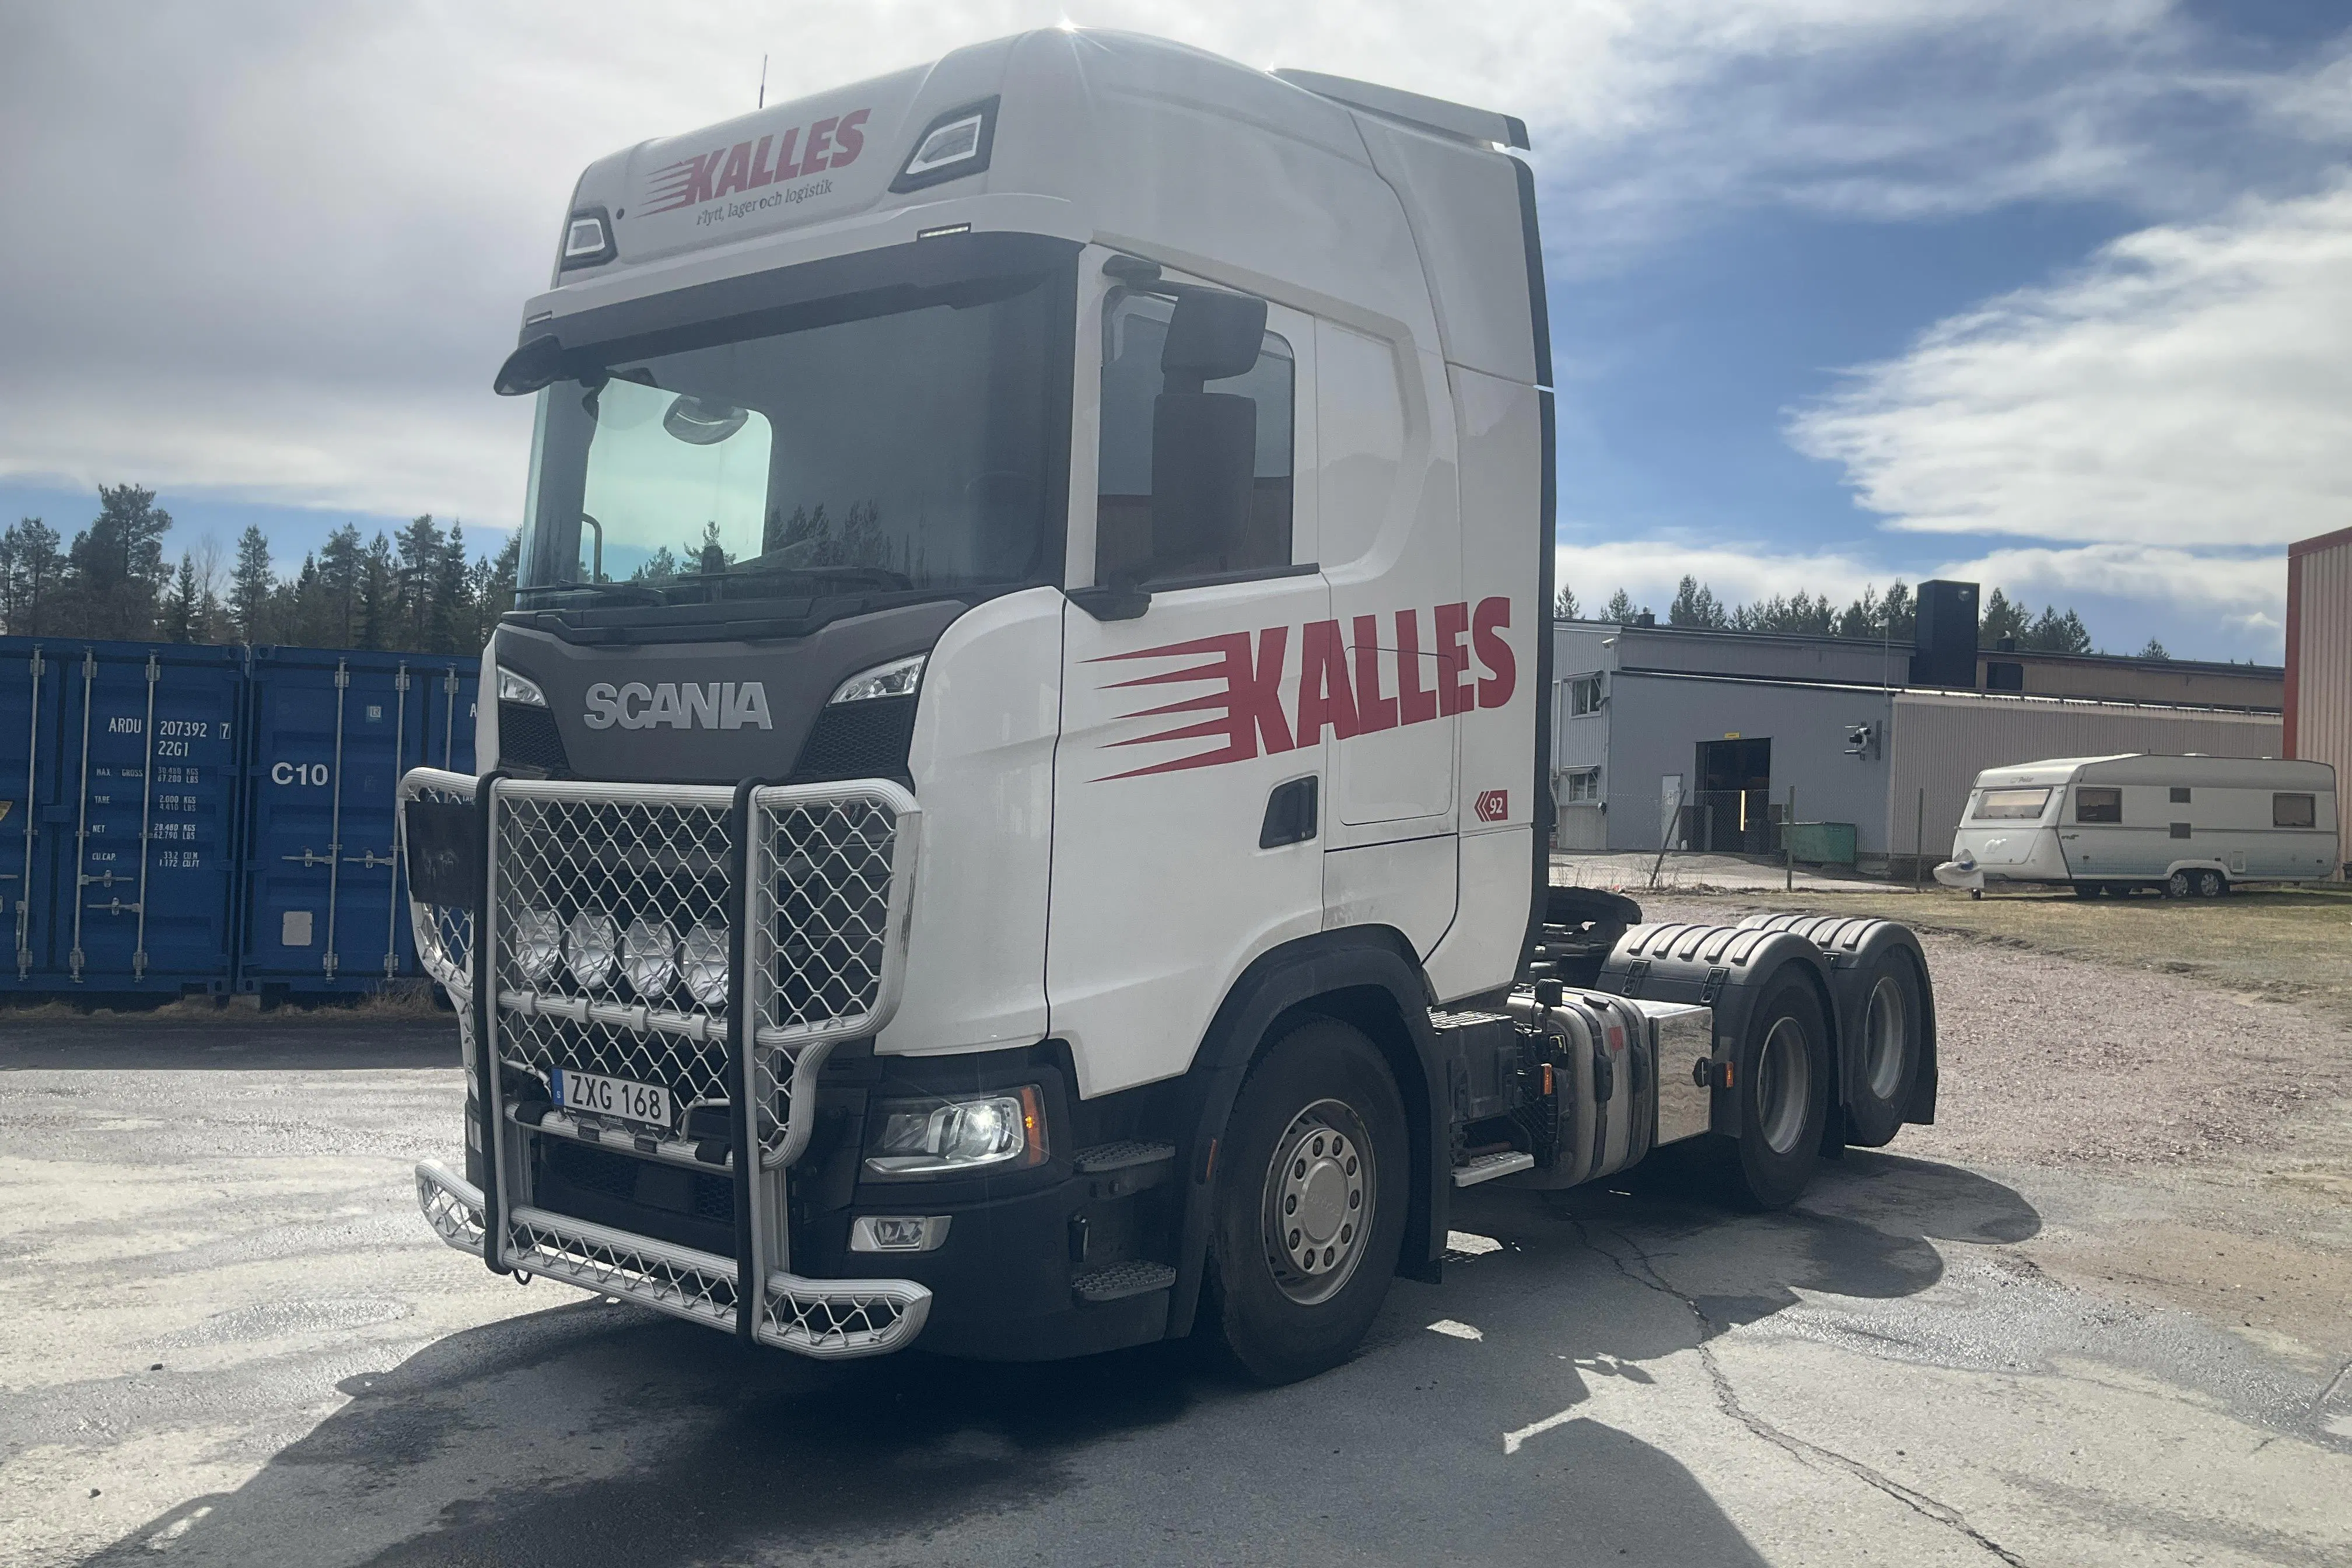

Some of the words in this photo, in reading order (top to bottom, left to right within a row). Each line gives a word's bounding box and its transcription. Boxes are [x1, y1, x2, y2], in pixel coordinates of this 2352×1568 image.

[681, 108, 872, 206] KALLES
[727, 200, 758, 219] lager
[760, 191, 783, 209] och
[785, 178, 834, 204] logistik
[1225, 596, 1517, 758] KALLES
[583, 682, 774, 730] SCANIA
[108, 718, 142, 734] ARDU
[159, 720, 208, 738] 207392
[222, 723, 229, 738] 7
[158, 740, 189, 757] 22G1
[96, 768, 111, 776] MAX
[121, 769, 144, 777] GROSS
[186, 775, 199, 783] LBS
[272, 762, 328, 786] C10
[94, 795, 111, 804] TARE
[1489, 797, 1503, 814] 92
[92, 825, 106, 833] NET
[183, 832, 195, 840] LBS
[556, 1090, 561, 1099] S
[570, 1074, 612, 1110] ZXG
[621, 1084, 662, 1119] 168
